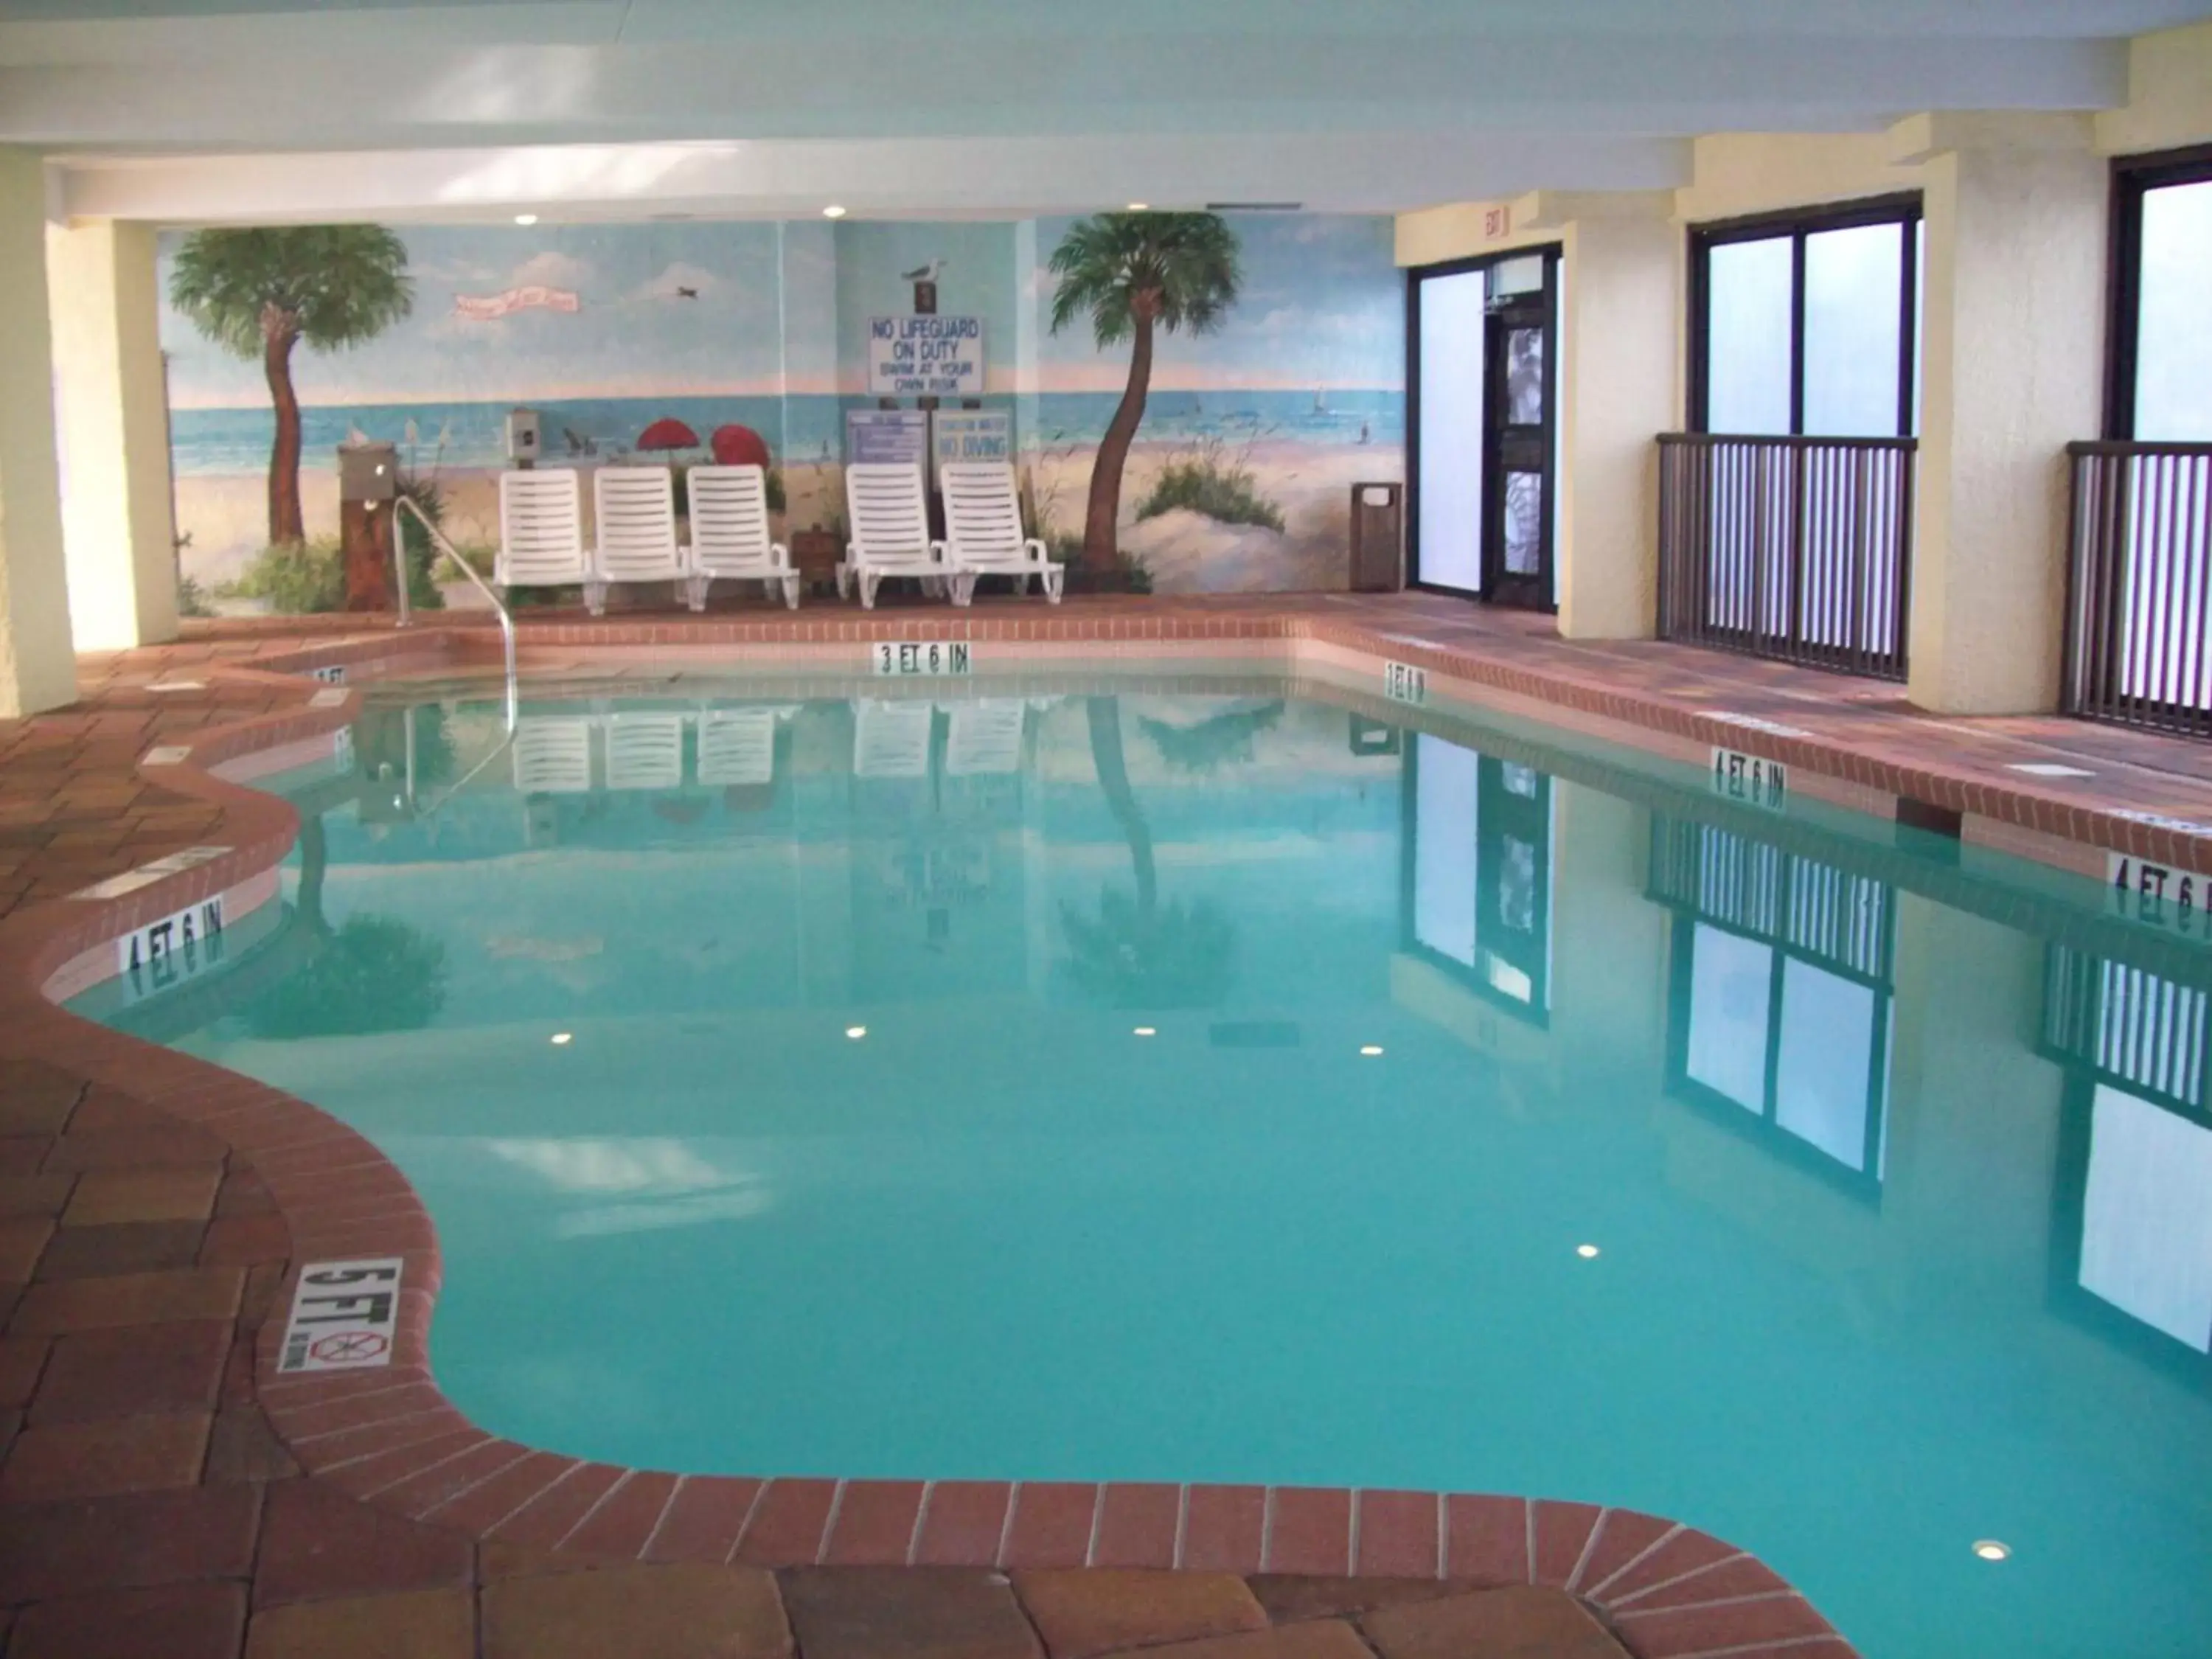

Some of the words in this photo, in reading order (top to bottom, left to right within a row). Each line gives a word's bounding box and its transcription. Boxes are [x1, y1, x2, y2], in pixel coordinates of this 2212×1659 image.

[872, 319, 894, 339] NO
[900, 319, 978, 339] LIFEGUARD
[893, 341, 914, 359] ON
[921, 341, 958, 359] DUTY
[963, 435, 1006, 457] DIVING
[2140, 864, 2169, 900] FT
[2180, 875, 2193, 908] 6
[305, 1267, 396, 1284] 5
[296, 1292, 392, 1324] FT
